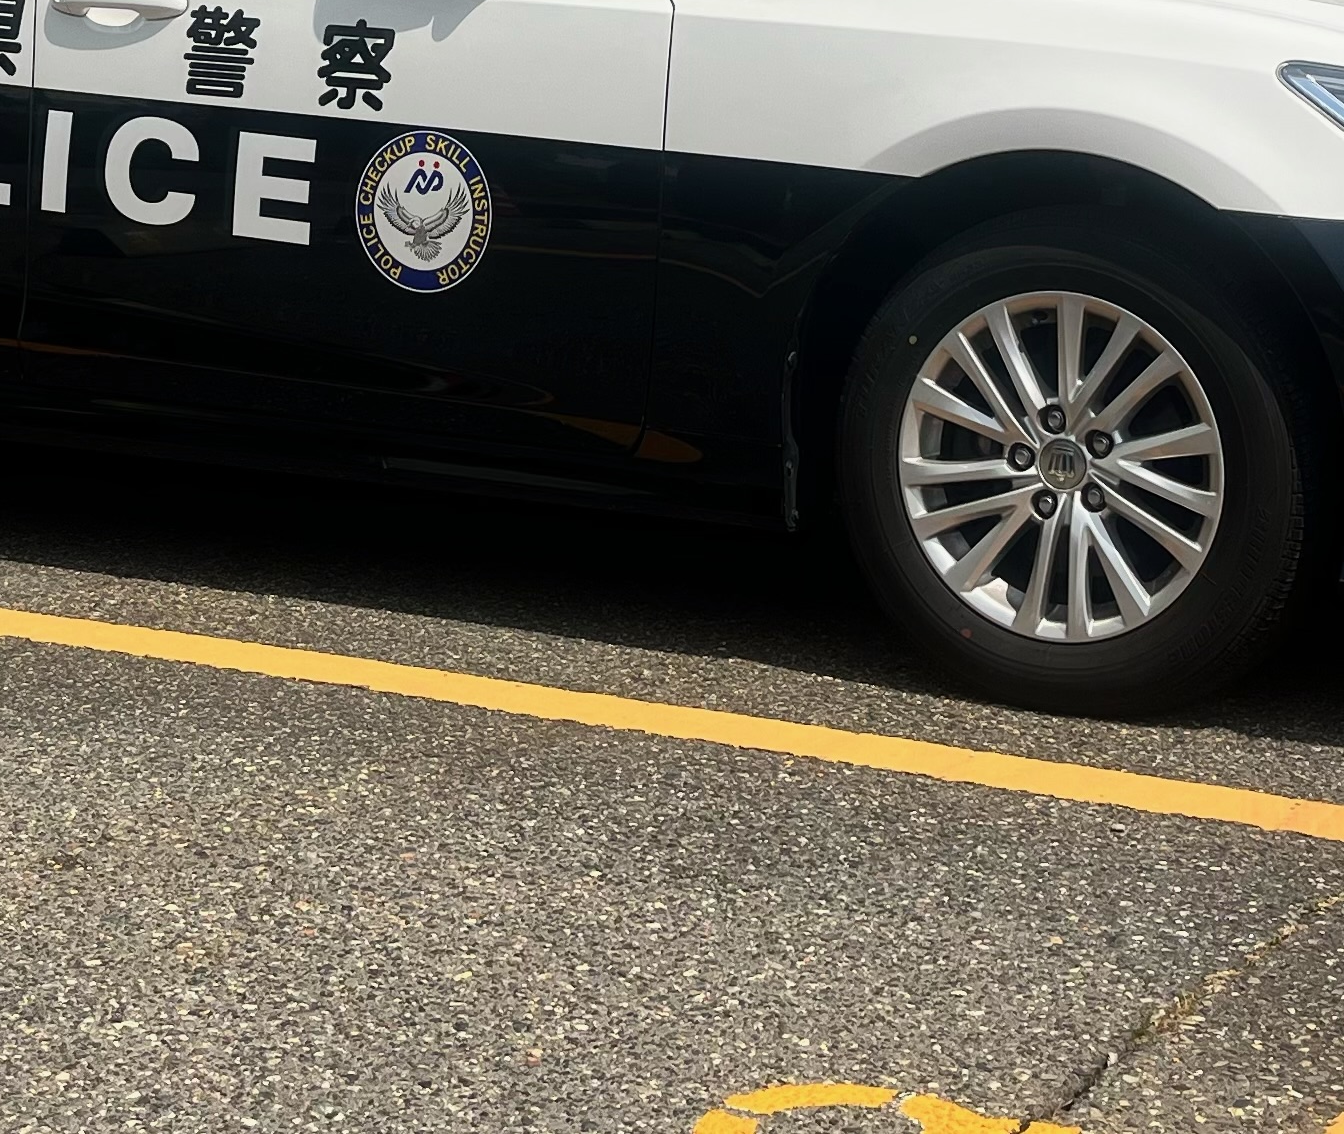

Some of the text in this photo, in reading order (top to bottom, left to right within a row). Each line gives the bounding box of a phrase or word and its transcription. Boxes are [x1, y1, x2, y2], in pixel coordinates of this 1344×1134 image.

[360, 135, 488, 286] POLICE CHECKUP SKILL INSTRUCTOR
